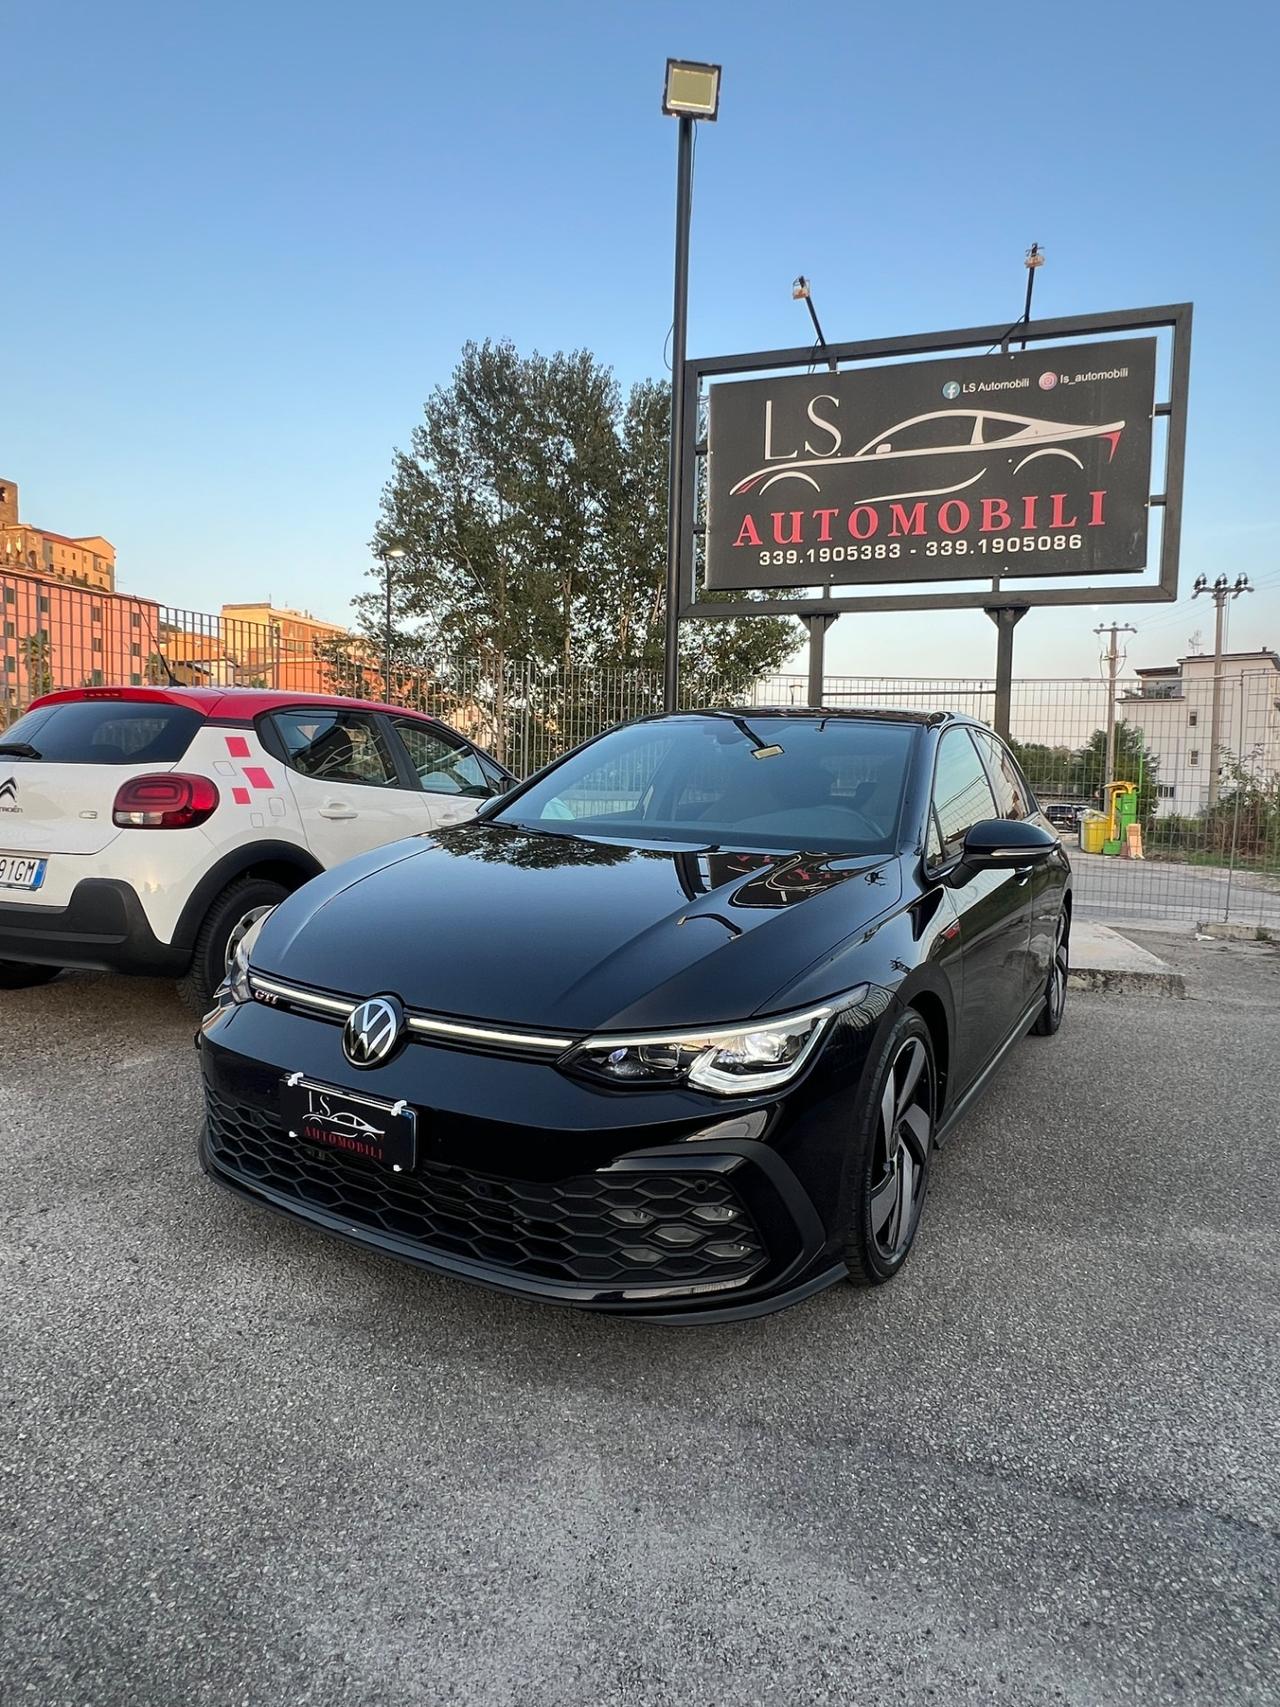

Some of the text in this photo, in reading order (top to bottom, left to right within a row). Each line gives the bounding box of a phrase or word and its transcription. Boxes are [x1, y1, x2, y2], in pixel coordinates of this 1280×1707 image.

[962, 378, 1030, 393] LS Automobili
[731, 490, 1107, 547] AUTOMOBILI
[758, 542, 902, 566] 339.1905383
[924, 533, 1083, 557] 339.1905086
[303, 1125, 384, 1161] AUTOMOBILI
